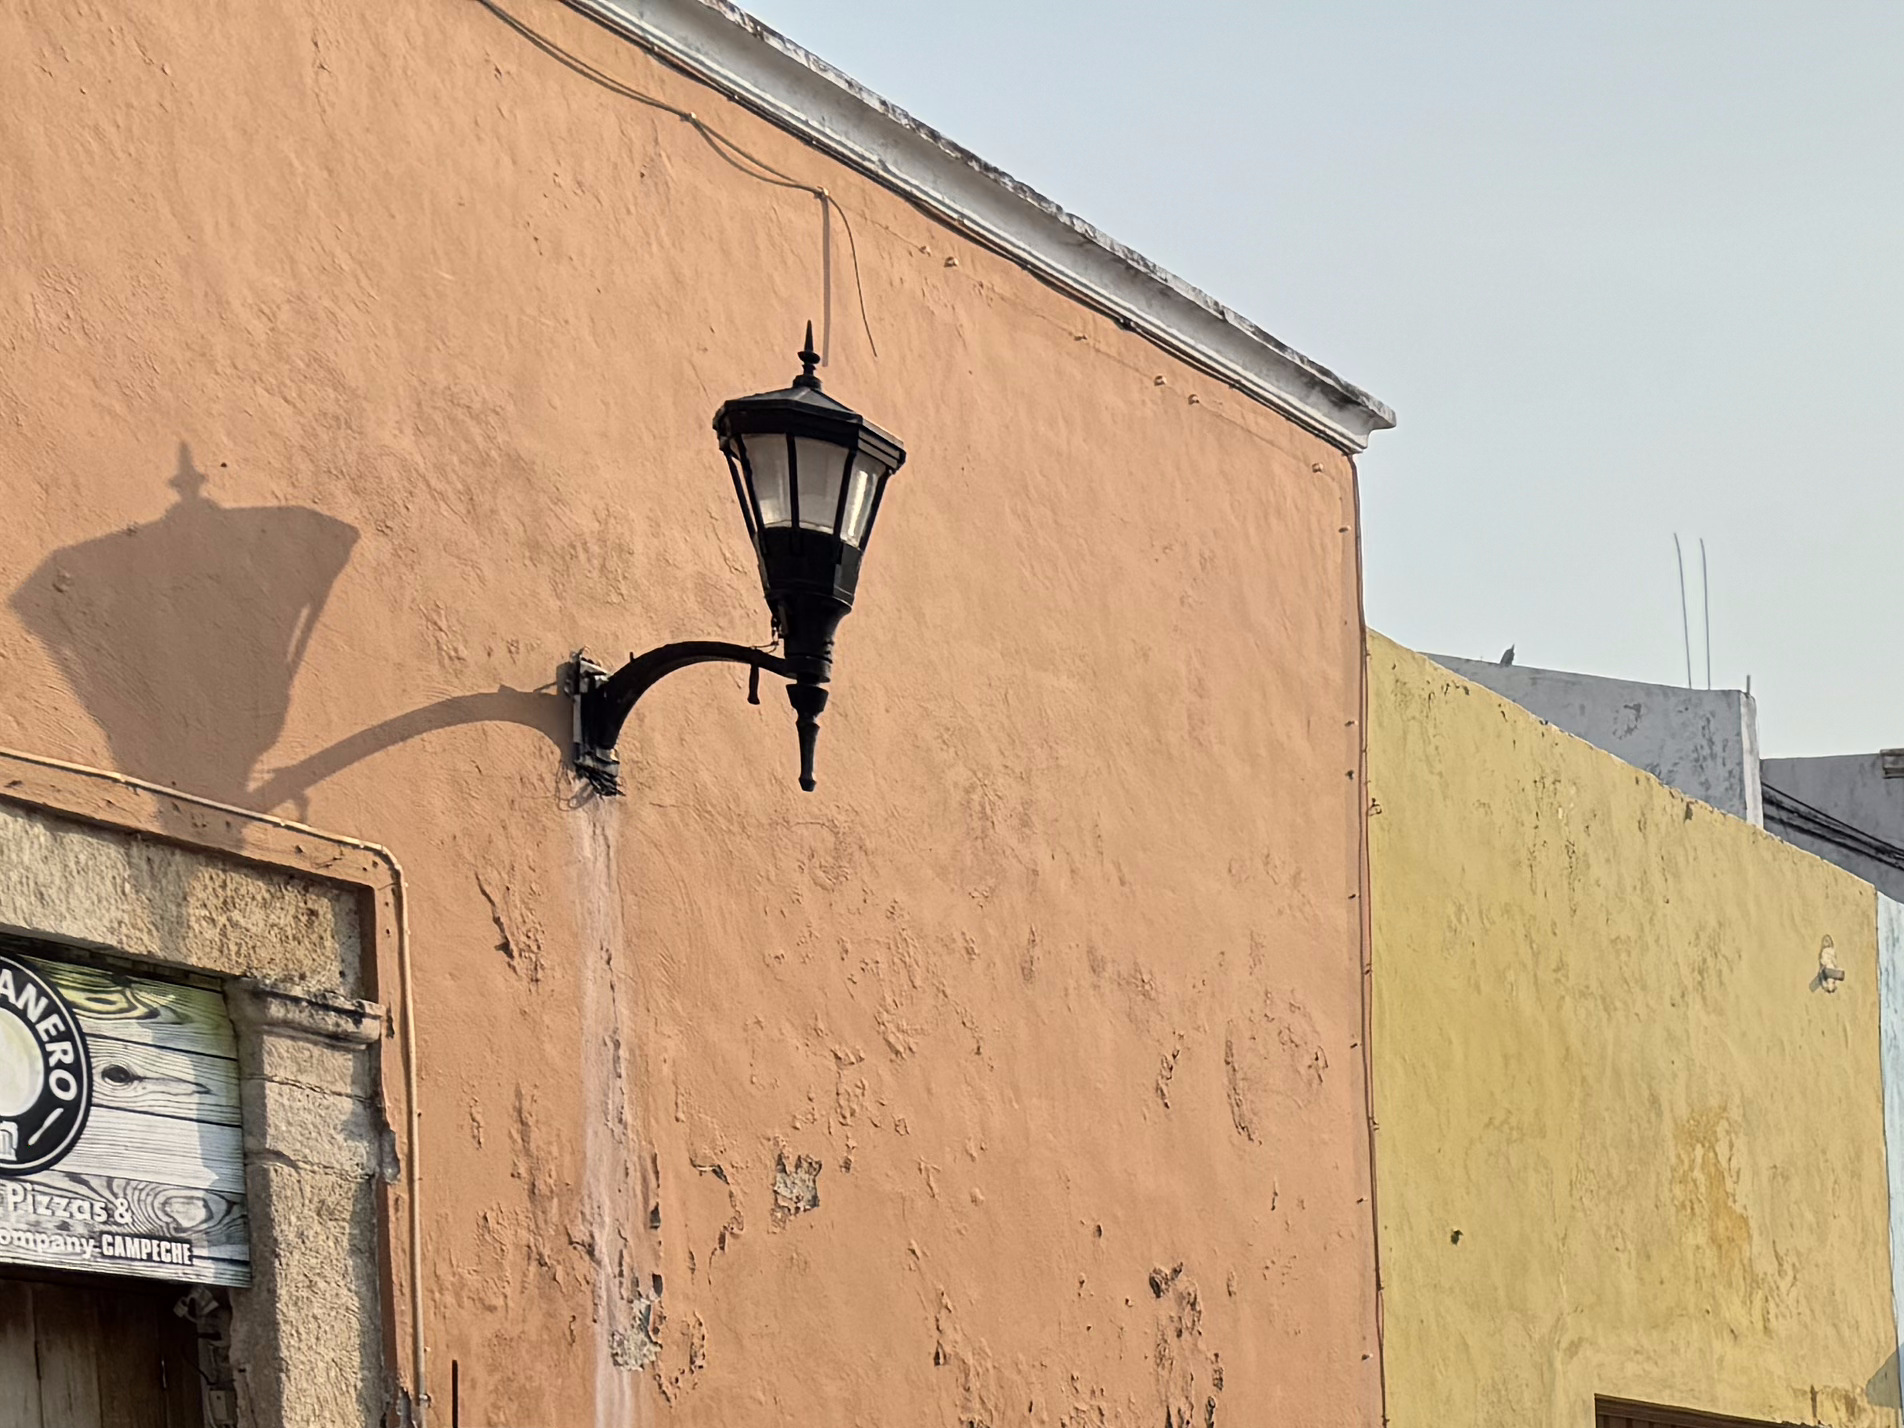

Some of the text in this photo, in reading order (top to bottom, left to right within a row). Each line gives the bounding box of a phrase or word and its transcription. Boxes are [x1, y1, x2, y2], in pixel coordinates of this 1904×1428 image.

[6, 1182, 133, 1225] Pizzas &
[101, 1233, 193, 1266] CAMPECHE
